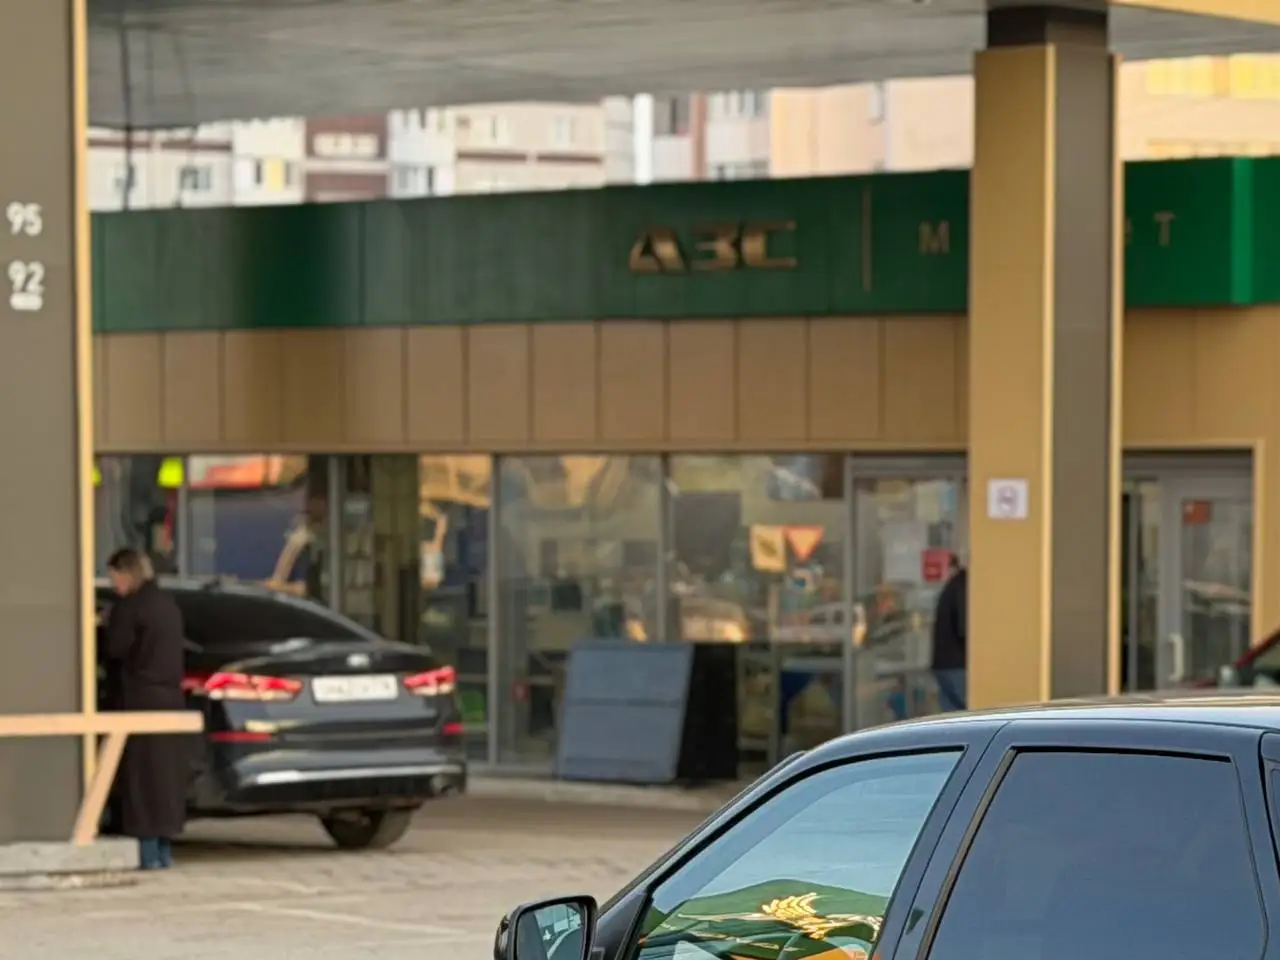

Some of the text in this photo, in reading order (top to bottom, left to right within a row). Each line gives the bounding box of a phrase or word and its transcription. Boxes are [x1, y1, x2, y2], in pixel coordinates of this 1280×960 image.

[6, 201, 42, 237] 95
[629, 218, 798, 276] АЗС
[8, 260, 45, 293] 92
